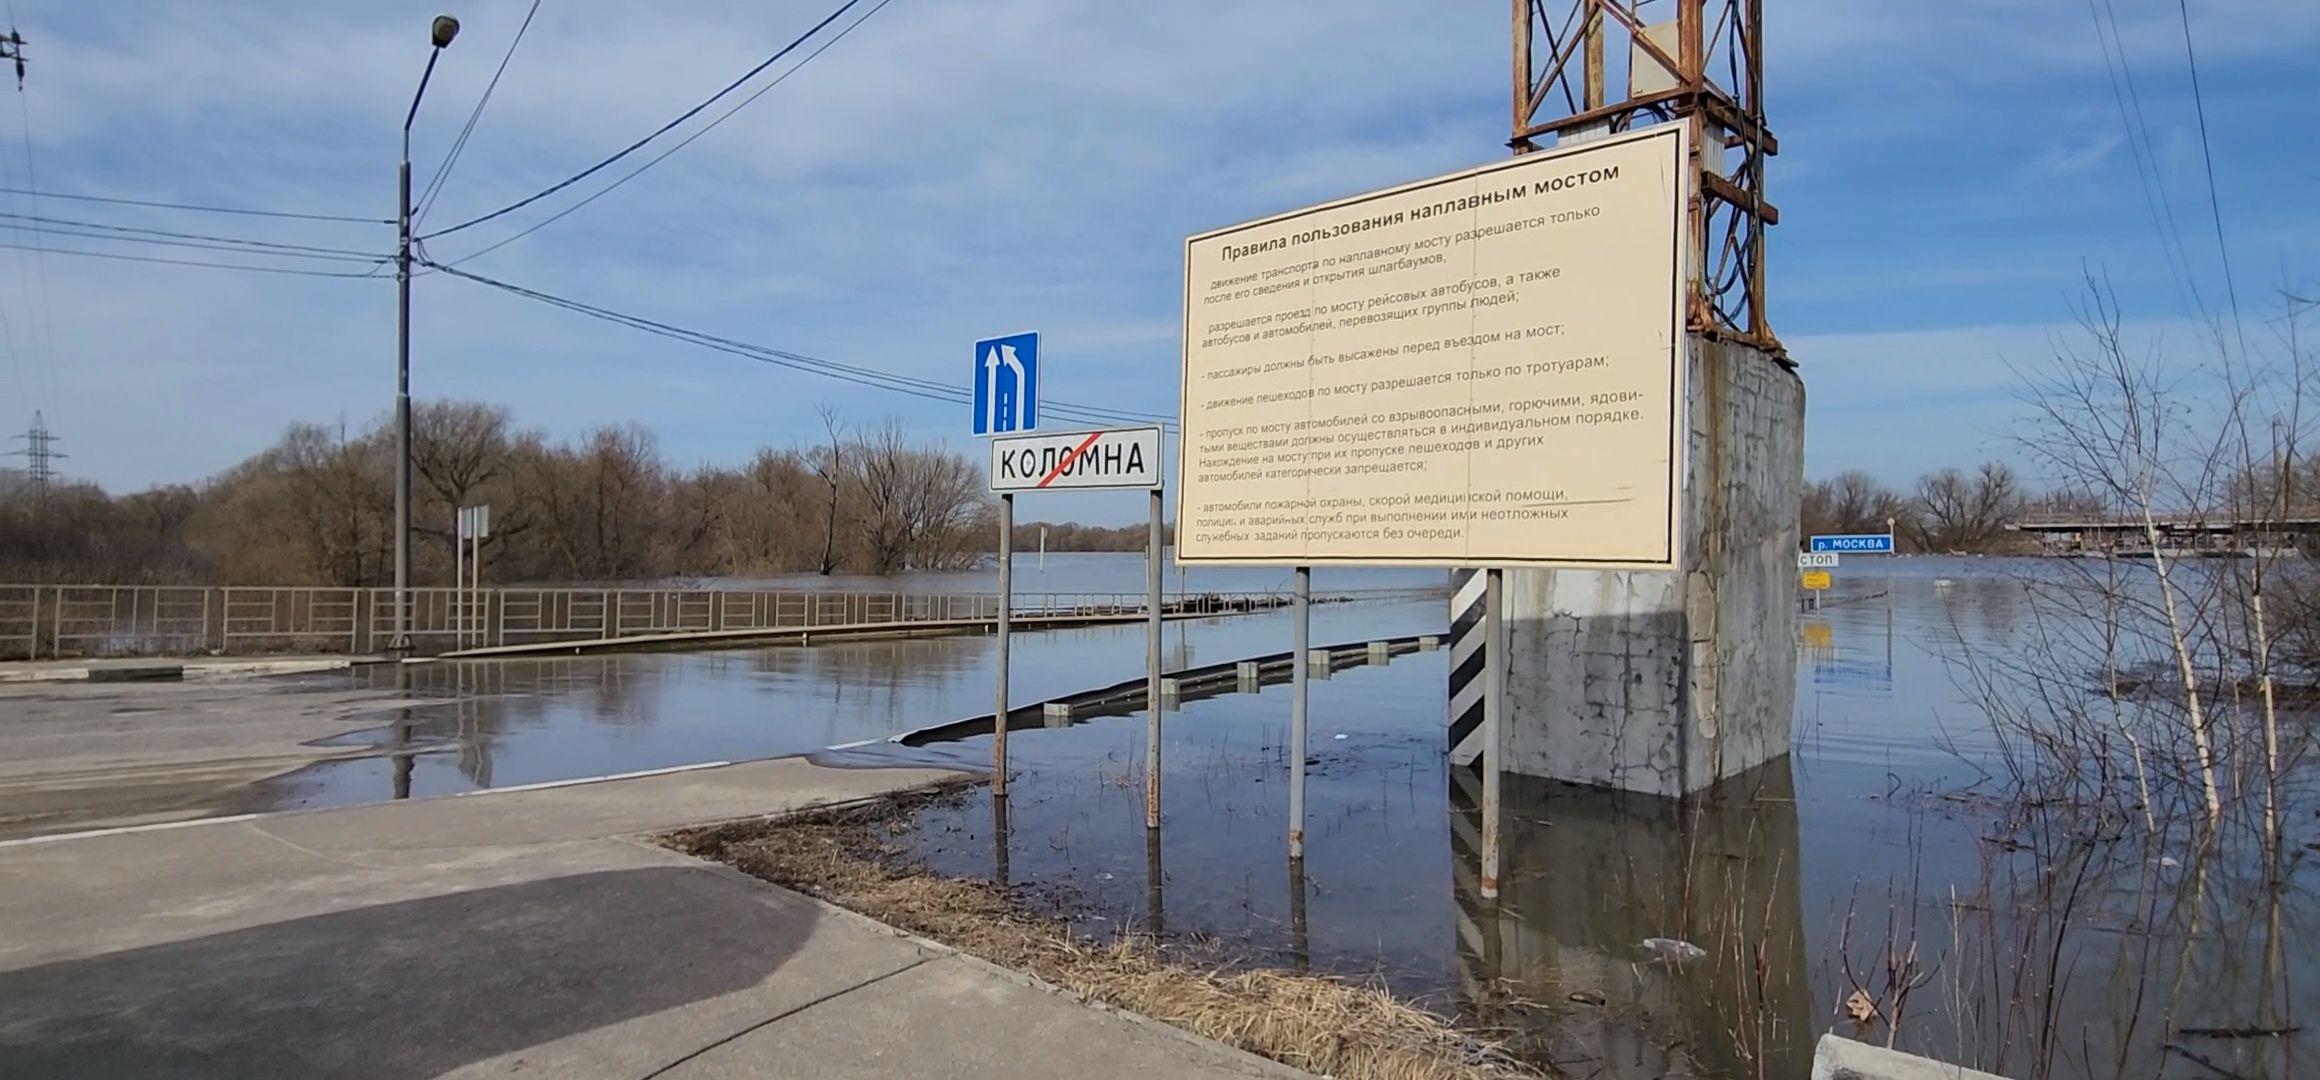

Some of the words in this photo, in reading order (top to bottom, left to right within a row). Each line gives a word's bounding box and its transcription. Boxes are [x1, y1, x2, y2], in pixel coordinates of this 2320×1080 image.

[1221, 236, 1289, 263] Правила
[1290, 211, 1404, 246] пользования
[1409, 184, 1527, 221] наплавным
[1533, 165, 1619, 195] мостом
[1209, 272, 1258, 291] движение
[1260, 259, 1320, 282] транспорта
[1321, 257, 1336, 267] по
[1338, 242, 1411, 265] наплавному
[1413, 234, 1452, 250] мосту
[1454, 216, 1545, 246] разрешается
[1548, 205, 1600, 224] только
[1203, 292, 1232, 305] после
[1233, 288, 1251, 300] его
[1251, 278, 1300, 297] сведения
[1302, 277, 1310, 286] и
[1311, 267, 1365, 285] открытия
[1208, 314, 1273, 335] разрешается
[1274, 307, 1311, 324] проезд
[1313, 305, 1328, 316] по
[1330, 299, 1366, 313] мосту
[1366, 289, 1427, 311] рейсовых
[1429, 277, 1502, 298] автобусов,
[1504, 274, 1514, 286] а
[1518, 267, 1561, 283] также
[1201, 332, 1251, 348] автобусов
[1252, 331, 1260, 341] и
[1338, 307, 1419, 328] перевозящих
[1421, 298, 1467, 318] группы
[1469, 289, 1520, 307] людей;
[1206, 365, 1262, 380] пассажиры
[1263, 359, 1305, 374] должны
[1306, 354, 1336, 366] быть
[1337, 346, 1399, 363] высажены
[1402, 340, 1441, 355] перед
[1443, 332, 1501, 349] въездом
[1504, 329, 1521, 341] на
[1525, 324, 1565, 338] мост;
[1205, 395, 1254, 410] движение
[1256, 389, 1315, 403] пешеходов
[1317, 386, 1331, 396] по
[1333, 382, 1368, 395] мосту
[1370, 372, 1452, 393] разрешается
[1455, 367, 1501, 381] только
[1504, 364, 1522, 376] по
[1525, 355, 1609, 377] тротуарам;
[1199, 443, 1225, 454] тыми
[1226, 438, 1289, 452] веществами
[1290, 434, 1335, 448] должны
[1337, 425, 1436, 445] осуществляться
[1439, 424, 1447, 435] в
[1450, 414, 1571, 435] индивидуальном
[1574, 407, 1644, 426] порядке.
[1205, 427, 1244, 440] пропуск
[1245, 425, 1259, 435] по
[1260, 422, 1291, 434] мосту
[1293, 412, 1368, 431] автомобилей
[1370, 413, 1386, 424] со
[1388, 403, 1505, 425] взрывоопасными,
[1508, 395, 1585, 414] горючими,
[1589, 390, 1643, 408] ядови-
[1001, 442, 1145, 479] КОЛОМНА
[1198, 455, 1260, 468] Нахождение
[1261, 454, 1275, 464] на
[1276, 452, 1309, 465] мосту
[1310, 450, 1331, 463] при
[1333, 449, 1348, 459] их
[1349, 445, 1405, 460] пропуске
[1408, 439, 1481, 455] пешеходов
[1483, 438, 1493, 449] и
[1495, 435, 1544, 451] других
[1197, 467, 1263, 483] автомобилей
[1264, 465, 1342, 479] категорически
[1344, 460, 1427, 475] запрещается;
[1202, 499, 1262, 513] автомобили
[1264, 496, 1317, 511] пожарной
[1319, 497, 1365, 510] охраны,
[1368, 492, 1411, 509] скорой
[1413, 489, 1502, 506] медицинской
[1238, 517, 1246, 526] и
[1308, 510, 1343, 527] служб
[1345, 513, 1367, 526] при
[1369, 511, 1447, 523] выполнении
[1450, 510, 1478, 521] ими
[1480, 508, 1569, 521] неотложных
[1195, 529, 1250, 545] служебных
[1254, 528, 1298, 542] заданий
[1300, 529, 1380, 543] пропускаются
[1382, 525, 1404, 539] без
[1406, 528, 1464, 542] очереди.
[1818, 541, 1829, 551] р.
[1832, 539, 1884, 549] МОСКВА
[1800, 555, 1833, 565] СТОП
